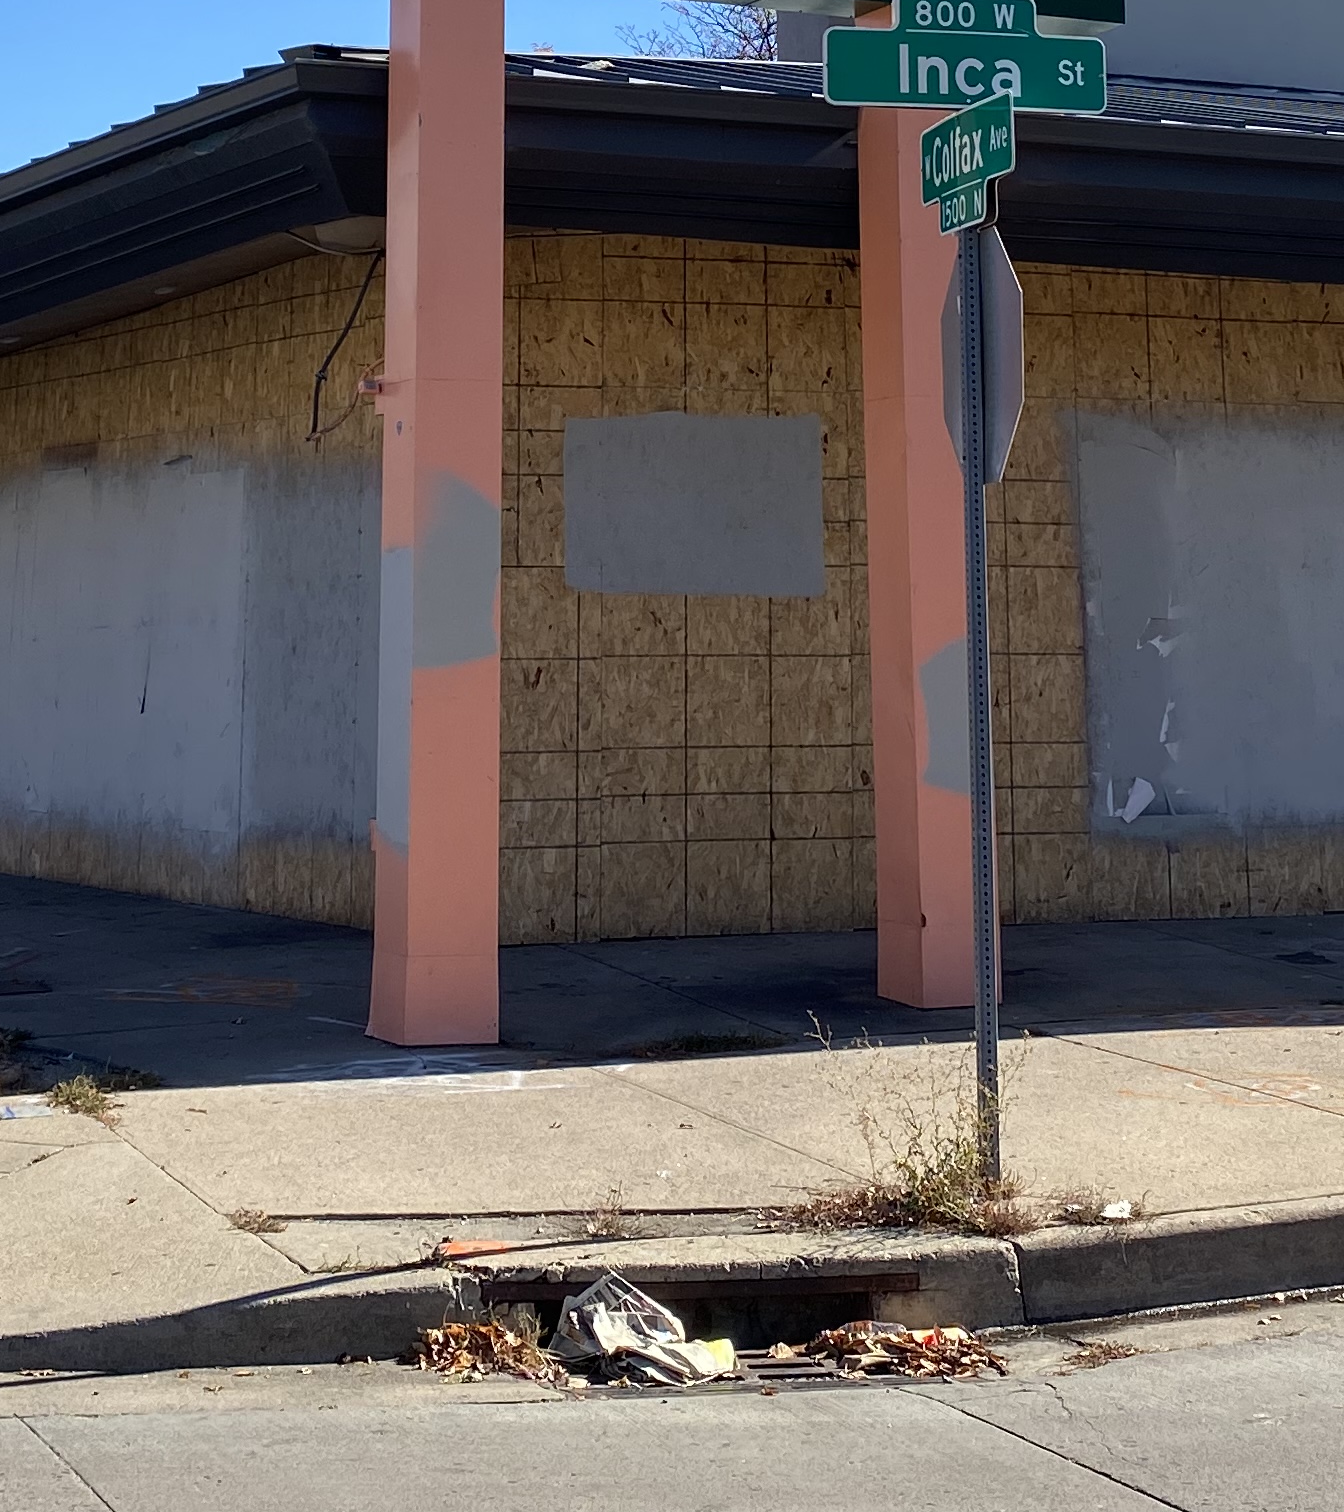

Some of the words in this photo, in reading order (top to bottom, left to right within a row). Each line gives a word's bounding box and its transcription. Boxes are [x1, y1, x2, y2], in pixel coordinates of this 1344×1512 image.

[915, 0, 976, 28] 800
[993, 3, 1015, 30] W
[899, 43, 1022, 98] Inca
[1057, 59, 1085, 87] St
[932, 126, 984, 187] Colfax
[989, 124, 1008, 153] Ave
[941, 194, 967, 229] 1500
[973, 188, 982, 217] N
